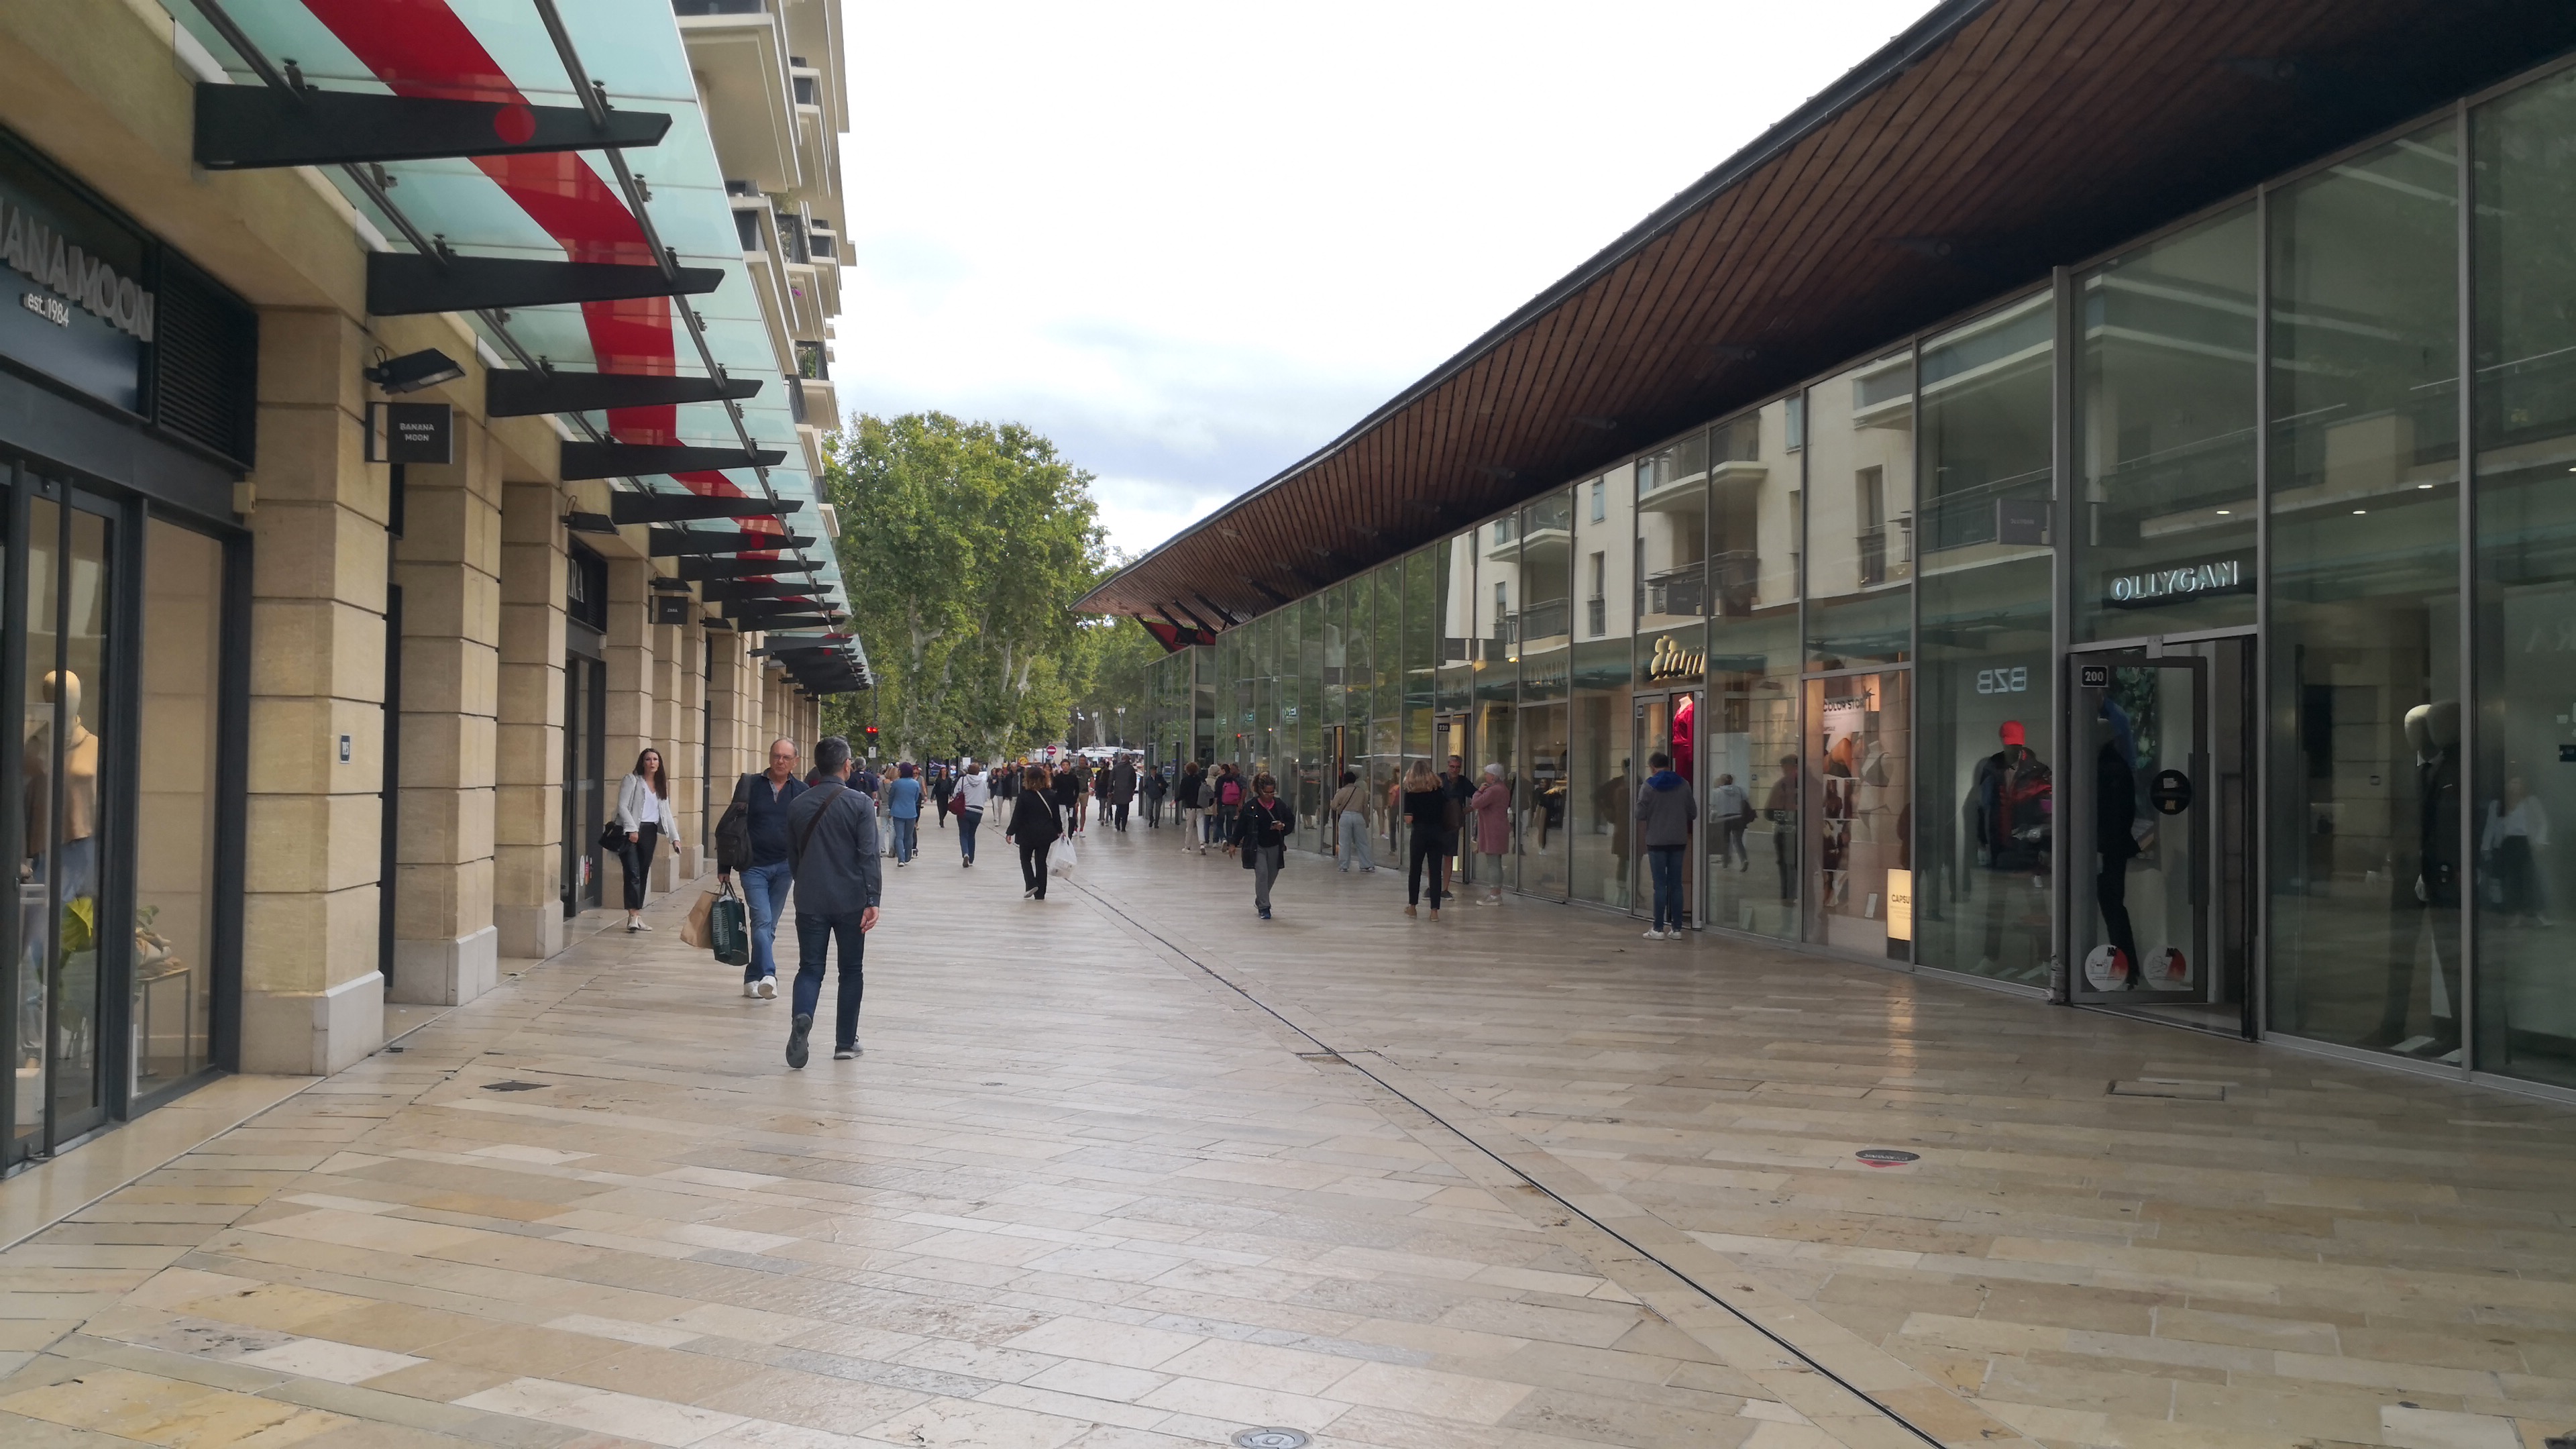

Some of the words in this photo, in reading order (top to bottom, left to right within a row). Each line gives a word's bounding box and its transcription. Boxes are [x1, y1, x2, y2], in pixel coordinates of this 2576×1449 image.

[399, 423, 435, 431] BANANA
[405, 433, 429, 441] MOON
[2110, 561, 2239, 601] OLLYGAN
[2085, 671, 2104, 682] 200
[1823, 700, 1846, 712] COLOR
